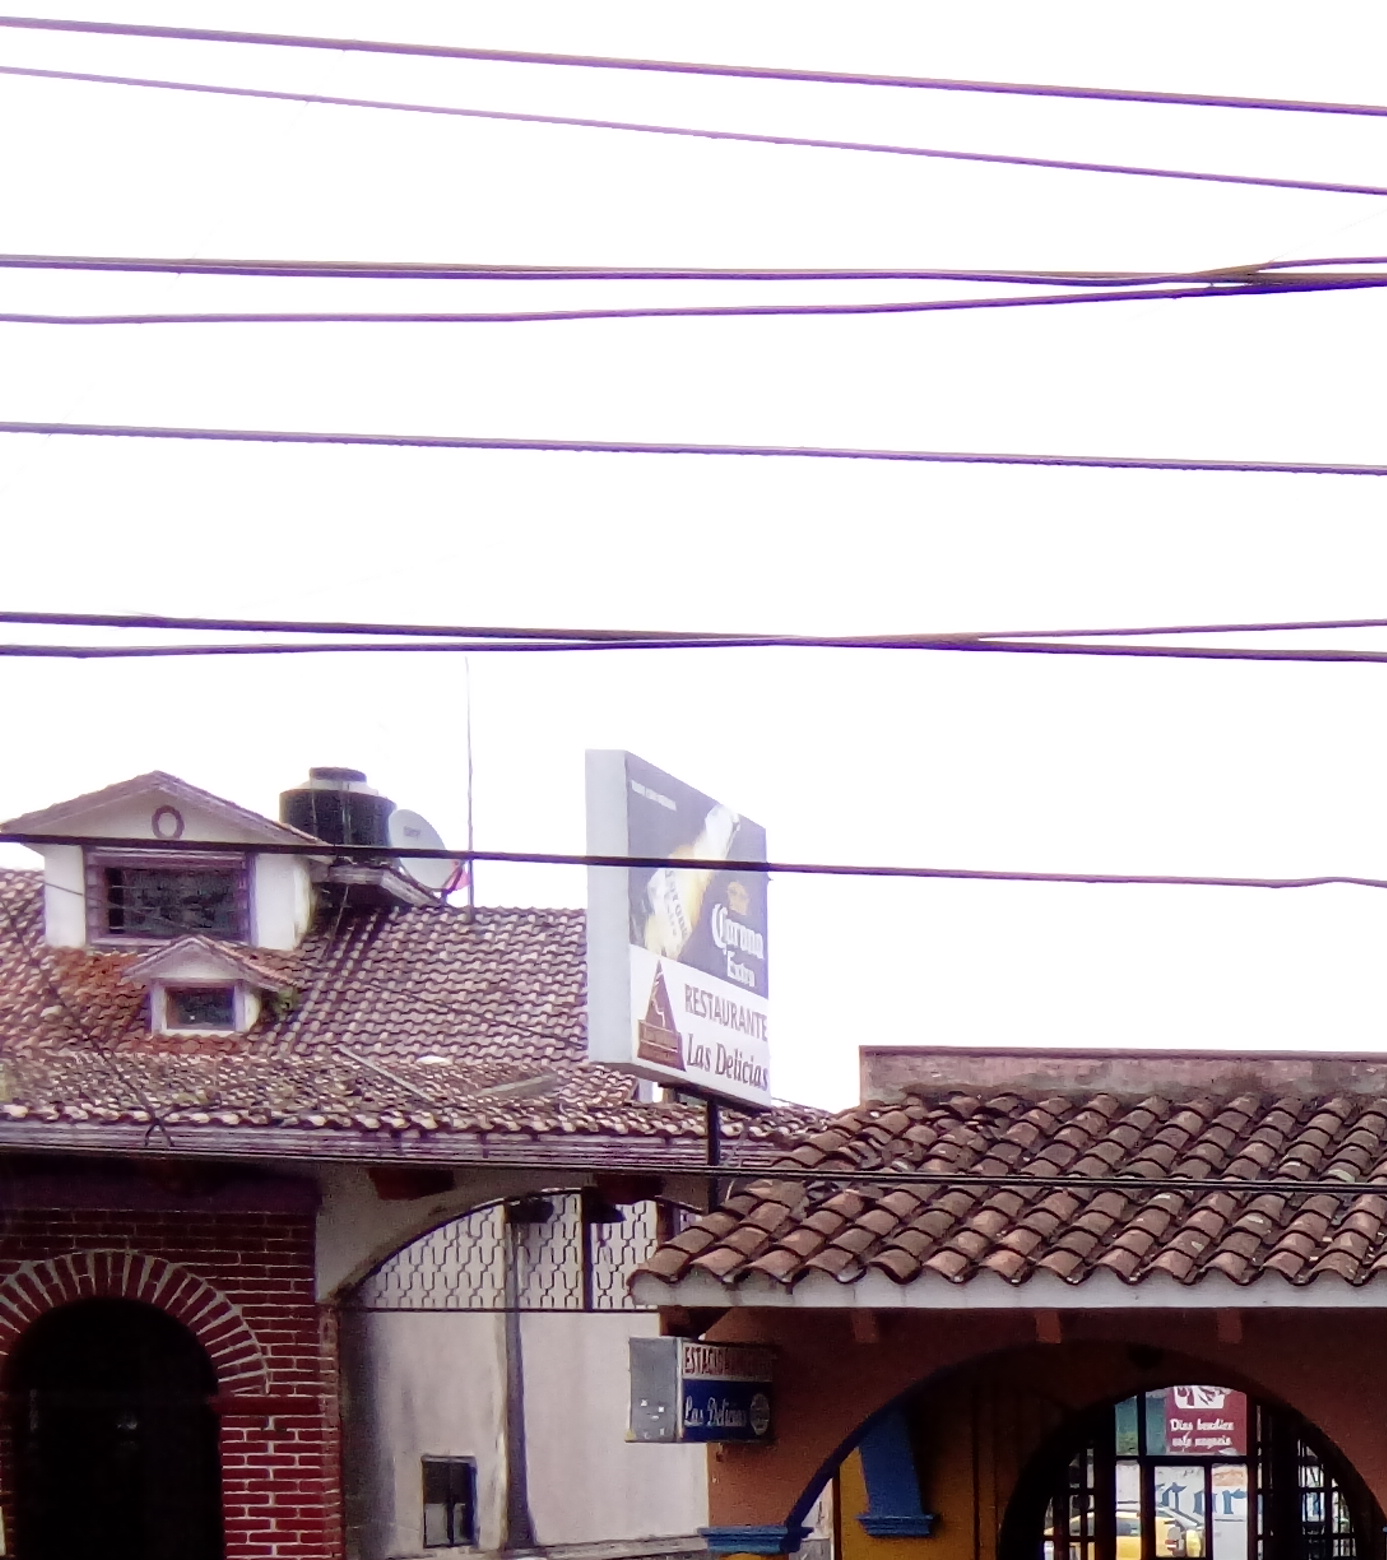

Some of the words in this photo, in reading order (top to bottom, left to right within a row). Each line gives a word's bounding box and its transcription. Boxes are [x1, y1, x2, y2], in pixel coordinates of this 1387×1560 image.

[685, 984, 768, 1042] RESTAURANTE
[687, 1033, 712, 1073] Las
[715, 1042, 768, 1091] Delicias
